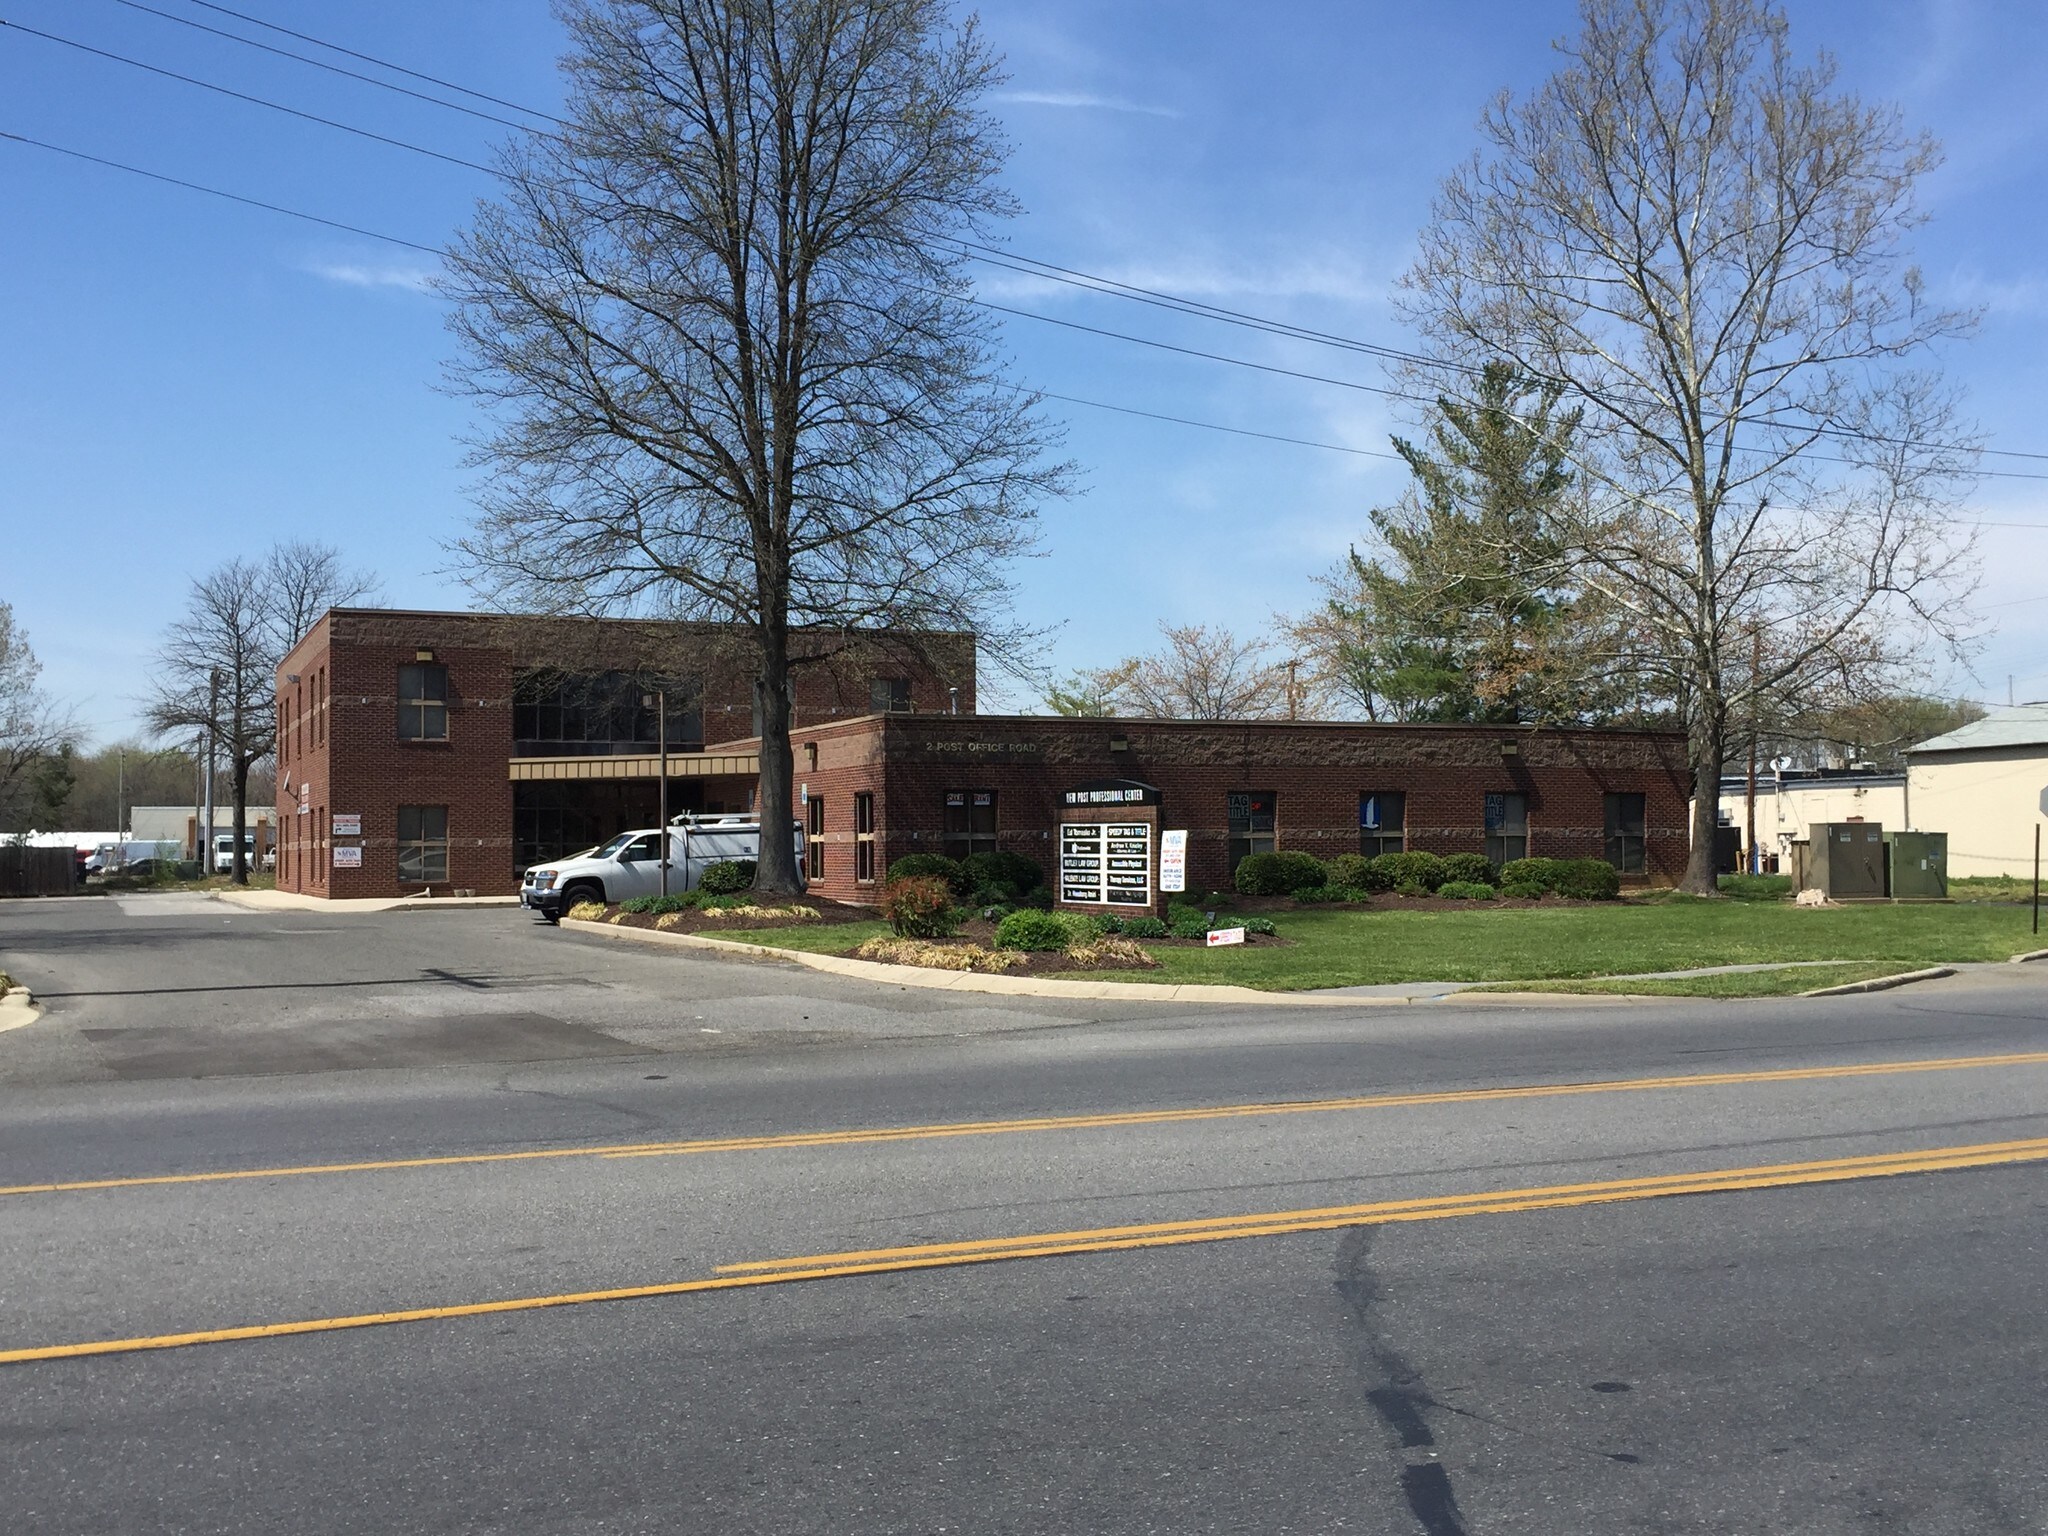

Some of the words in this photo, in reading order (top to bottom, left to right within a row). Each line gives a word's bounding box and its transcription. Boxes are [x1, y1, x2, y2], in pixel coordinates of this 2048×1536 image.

[926, 742, 933, 751] 2
[937, 742, 963, 752] POST
[968, 742, 1004, 752] OFFICE
[1009, 743, 1037, 753] ROAD
[1066, 792, 1076, 803] NEW
[1077, 791, 1089, 803] POST
[1089, 790, 1124, 802] PROFESSIONAL
[1124, 789, 1143, 801] CENTER
[1228, 795, 1248, 806] TAG
[1485, 795, 1502, 805] TAG
[1228, 807, 1248, 817] TITLE
[1485, 806, 1503, 817] TITLE
